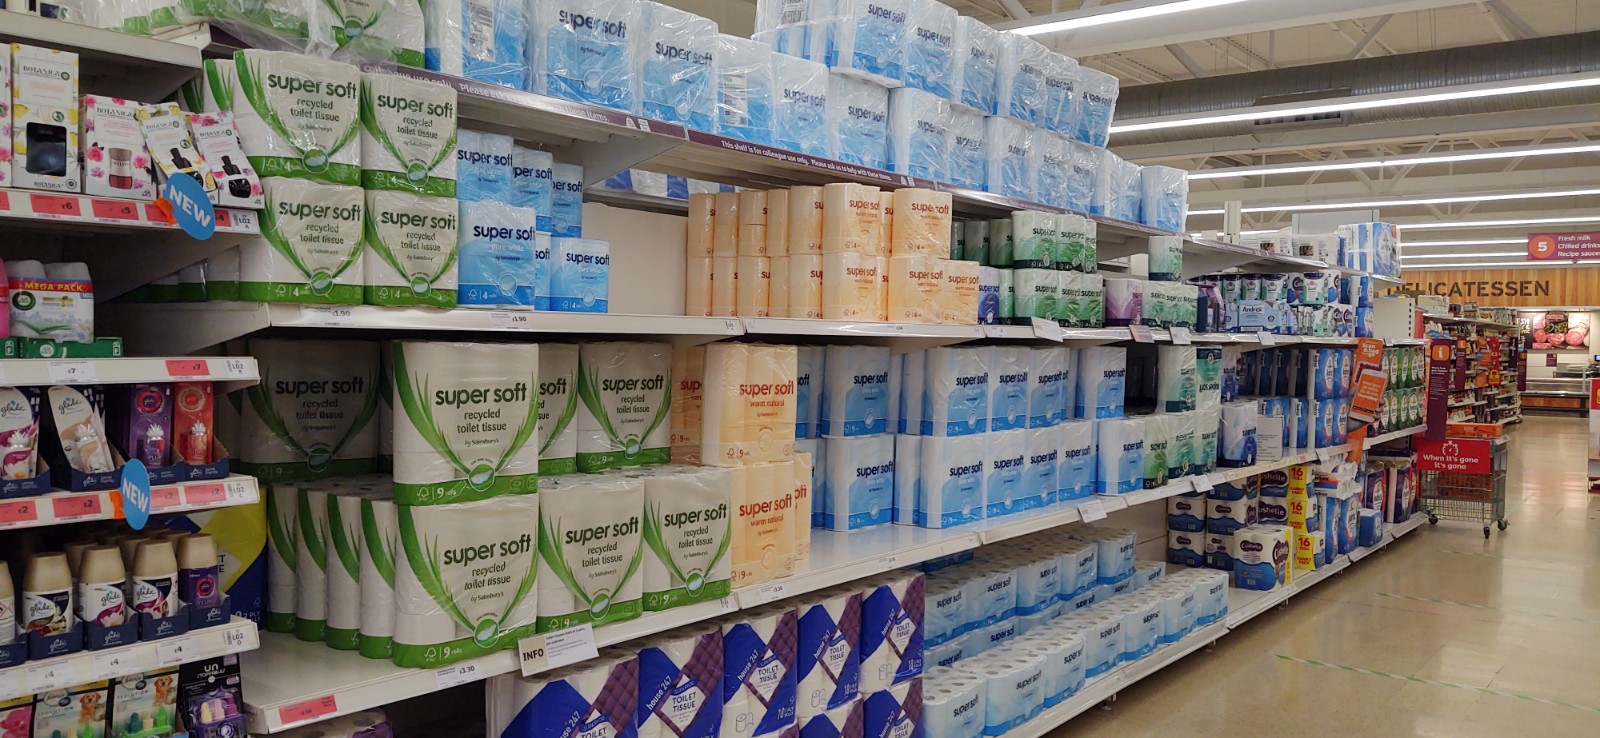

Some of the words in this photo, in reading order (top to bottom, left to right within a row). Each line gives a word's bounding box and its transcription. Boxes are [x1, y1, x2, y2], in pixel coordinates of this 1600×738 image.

[559, 9, 600, 30] super
[602, 19, 627, 38] soft
[23, 65, 61, 78] BOTANICA
[267, 73, 322, 94] super
[326, 82, 357, 99] soft
[459, 83, 489, 96] Please
[297, 98, 333, 110] recycled
[783, 87, 808, 104] super
[808, 95, 826, 108] soft
[97, 107, 133, 118] BOTANICA
[377, 94, 424, 112] super
[427, 102, 453, 118] soft
[290, 108, 313, 119] toilet
[315, 112, 340, 122] tissue
[403, 116, 433, 127] recycled
[587, 110, 610, 122] items.
[397, 126, 416, 136] toilet
[418, 128, 438, 139] tissue
[721, 140, 734, 150] This
[735, 143, 748, 152] shelf
[753, 147, 761, 155] for
[761, 149, 787, 160] colleague
[787, 154, 796, 162] use
[796, 156, 809, 166] only.
[810, 158, 827, 168] Please
[846, 166, 857, 174] help
[866, 170, 879, 178] these
[168, 185, 211, 228] NEW
[278, 201, 329, 220] super
[332, 204, 361, 221] soft
[912, 202, 934, 214] super
[935, 204, 949, 215] soft
[381, 211, 429, 228] super
[430, 215, 456, 230] soft
[306, 223, 339, 234] recycled
[473, 225, 512, 241] super
[515, 228, 535, 241] soft
[300, 234, 320, 244] toilet
[322, 235, 344, 245] tissue
[407, 232, 435, 242] recycled
[401, 240, 419, 250] toilet
[421, 241, 441, 252] tissue
[1538, 242, 1547, 251] 5
[25, 281, 55, 291] MEGA
[57, 281, 83, 292] PACK
[1387, 280, 1549, 297] EICATESSEN
[602, 376, 638, 394] super
[640, 374, 664, 391] soft
[854, 374, 876, 386] super
[876, 372, 888, 384] soft
[275, 378, 328, 396] super
[331, 377, 364, 394] soft
[539, 378, 567, 396] soft
[740, 383, 772, 398] super
[775, 380, 794, 395] soft
[435, 388, 490, 408] super
[493, 383, 527, 402] soft
[621, 395, 645, 405] recycled
[302, 399, 339, 409] recycled
[617, 406, 631, 414] toilet
[632, 405, 650, 413] tissue
[296, 410, 318, 420] toilet
[319, 410, 344, 420] tissue
[464, 408, 501, 421] recycled
[457, 423, 480, 433] toilet
[482, 421, 507, 432] tissue
[1459, 456, 1479, 464] gone
[857, 464, 880, 477] super
[881, 461, 894, 474] soft
[950, 465, 970, 478] super
[970, 461, 983, 473] soft
[1291, 467, 1303, 477] 16
[122, 477, 149, 514] NEW
[739, 501, 772, 518] super
[774, 494, 793, 511] soft
[1291, 502, 1302, 512] 16
[664, 508, 702, 528] super
[704, 503, 727, 521] soft
[565, 523, 610, 545] super
[612, 516, 639, 537] soft
[683, 526, 709, 538] recycled
[587, 542, 618, 555] recycled
[678, 538, 694, 549] toilet
[696, 537, 713, 546] tissue
[1298, 537, 1310, 547] 16
[443, 542, 496, 567] super
[499, 533, 532, 556] soft
[582, 555, 600, 568] toilet
[602, 554, 623, 564] tissue
[472, 562, 506, 577] recycled
[464, 578, 486, 591] toilet
[487, 574, 511, 587] tissue
[101, 592, 121, 607] glade
[136, 586, 156, 601] glade
[30, 602, 53, 616] glade
[896, 623, 910, 633] TOILET
[991, 630, 1006, 642] super
[522, 648, 544, 662] INFO
[829, 644, 845, 655] TOILET
[830, 651, 845, 661] TISSUE
[460, 665, 475, 674] £3.30
[758, 665, 779, 676] TOILET
[759, 673, 778, 683] TISSUE
[1016, 677, 1032, 690] super
[646, 688, 664, 710] house
[660, 675, 672, 691] 247
[673, 692, 697, 704] TOILET
[673, 700, 696, 712] TISSUE
[954, 702, 969, 717] super
